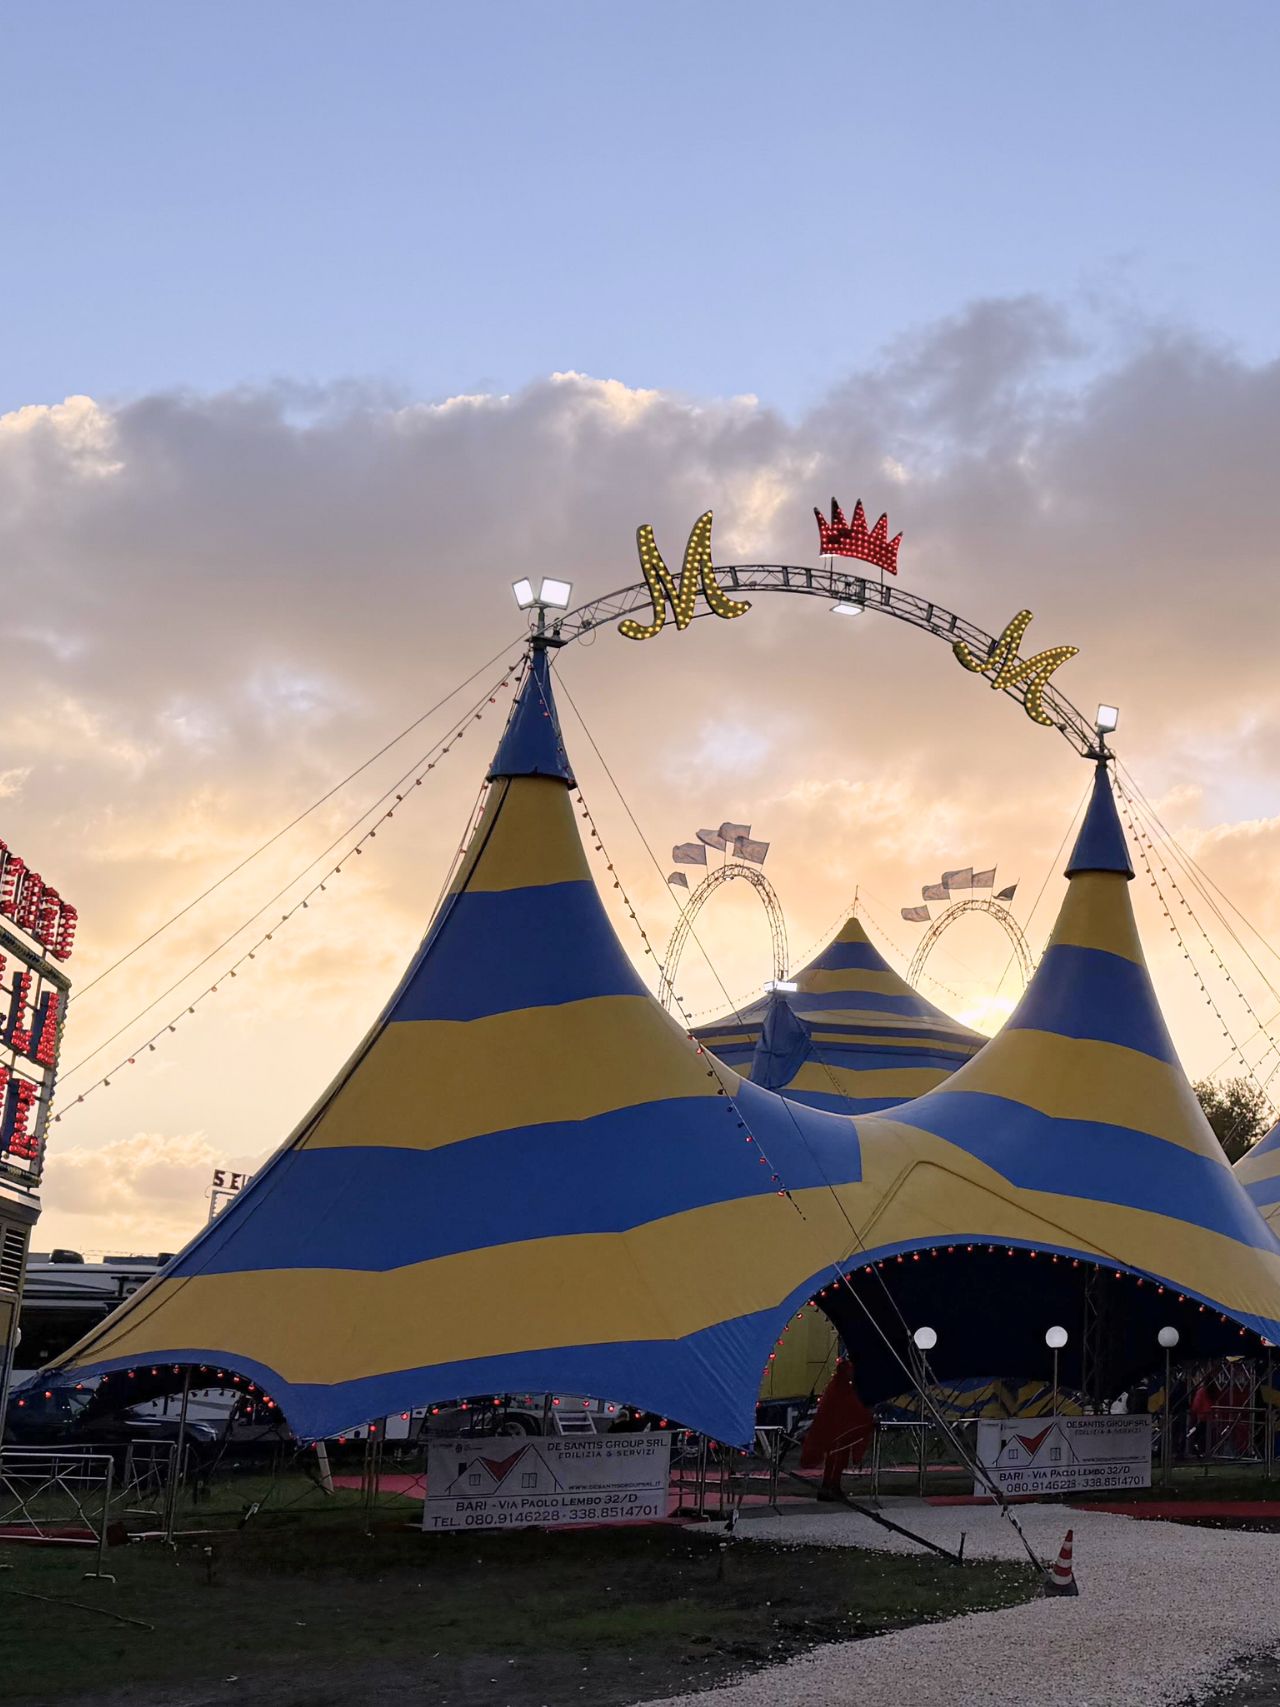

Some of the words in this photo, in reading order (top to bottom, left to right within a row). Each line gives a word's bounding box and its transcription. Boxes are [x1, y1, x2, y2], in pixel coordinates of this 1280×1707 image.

[618, 510, 752, 641] M
[952, 609, 1080, 727] M
[212, 1169, 254, 1190] SE
[547, 1442, 561, 1452] DE
[563, 1441, 602, 1451] SANTIS
[605, 1440, 644, 1450] GROUP
[646, 1439, 668, 1448] SRL
[558, 1451, 602, 1460] EDILIZIA
[616, 1449, 655, 1457] SERVIZI
[1000, 1471, 1024, 1481] BARI
[1106, 1465, 1130, 1475] 32/D
[456, 1500, 487, 1512] BARI
[521, 1498, 558, 1509] PAOLO
[561, 1496, 602, 1507] LEMBO
[604, 1493, 638, 1505] 32/D
[465, 1510, 560, 1526] 080.9146228
[569, 1505, 658, 1520] 338.8514701
